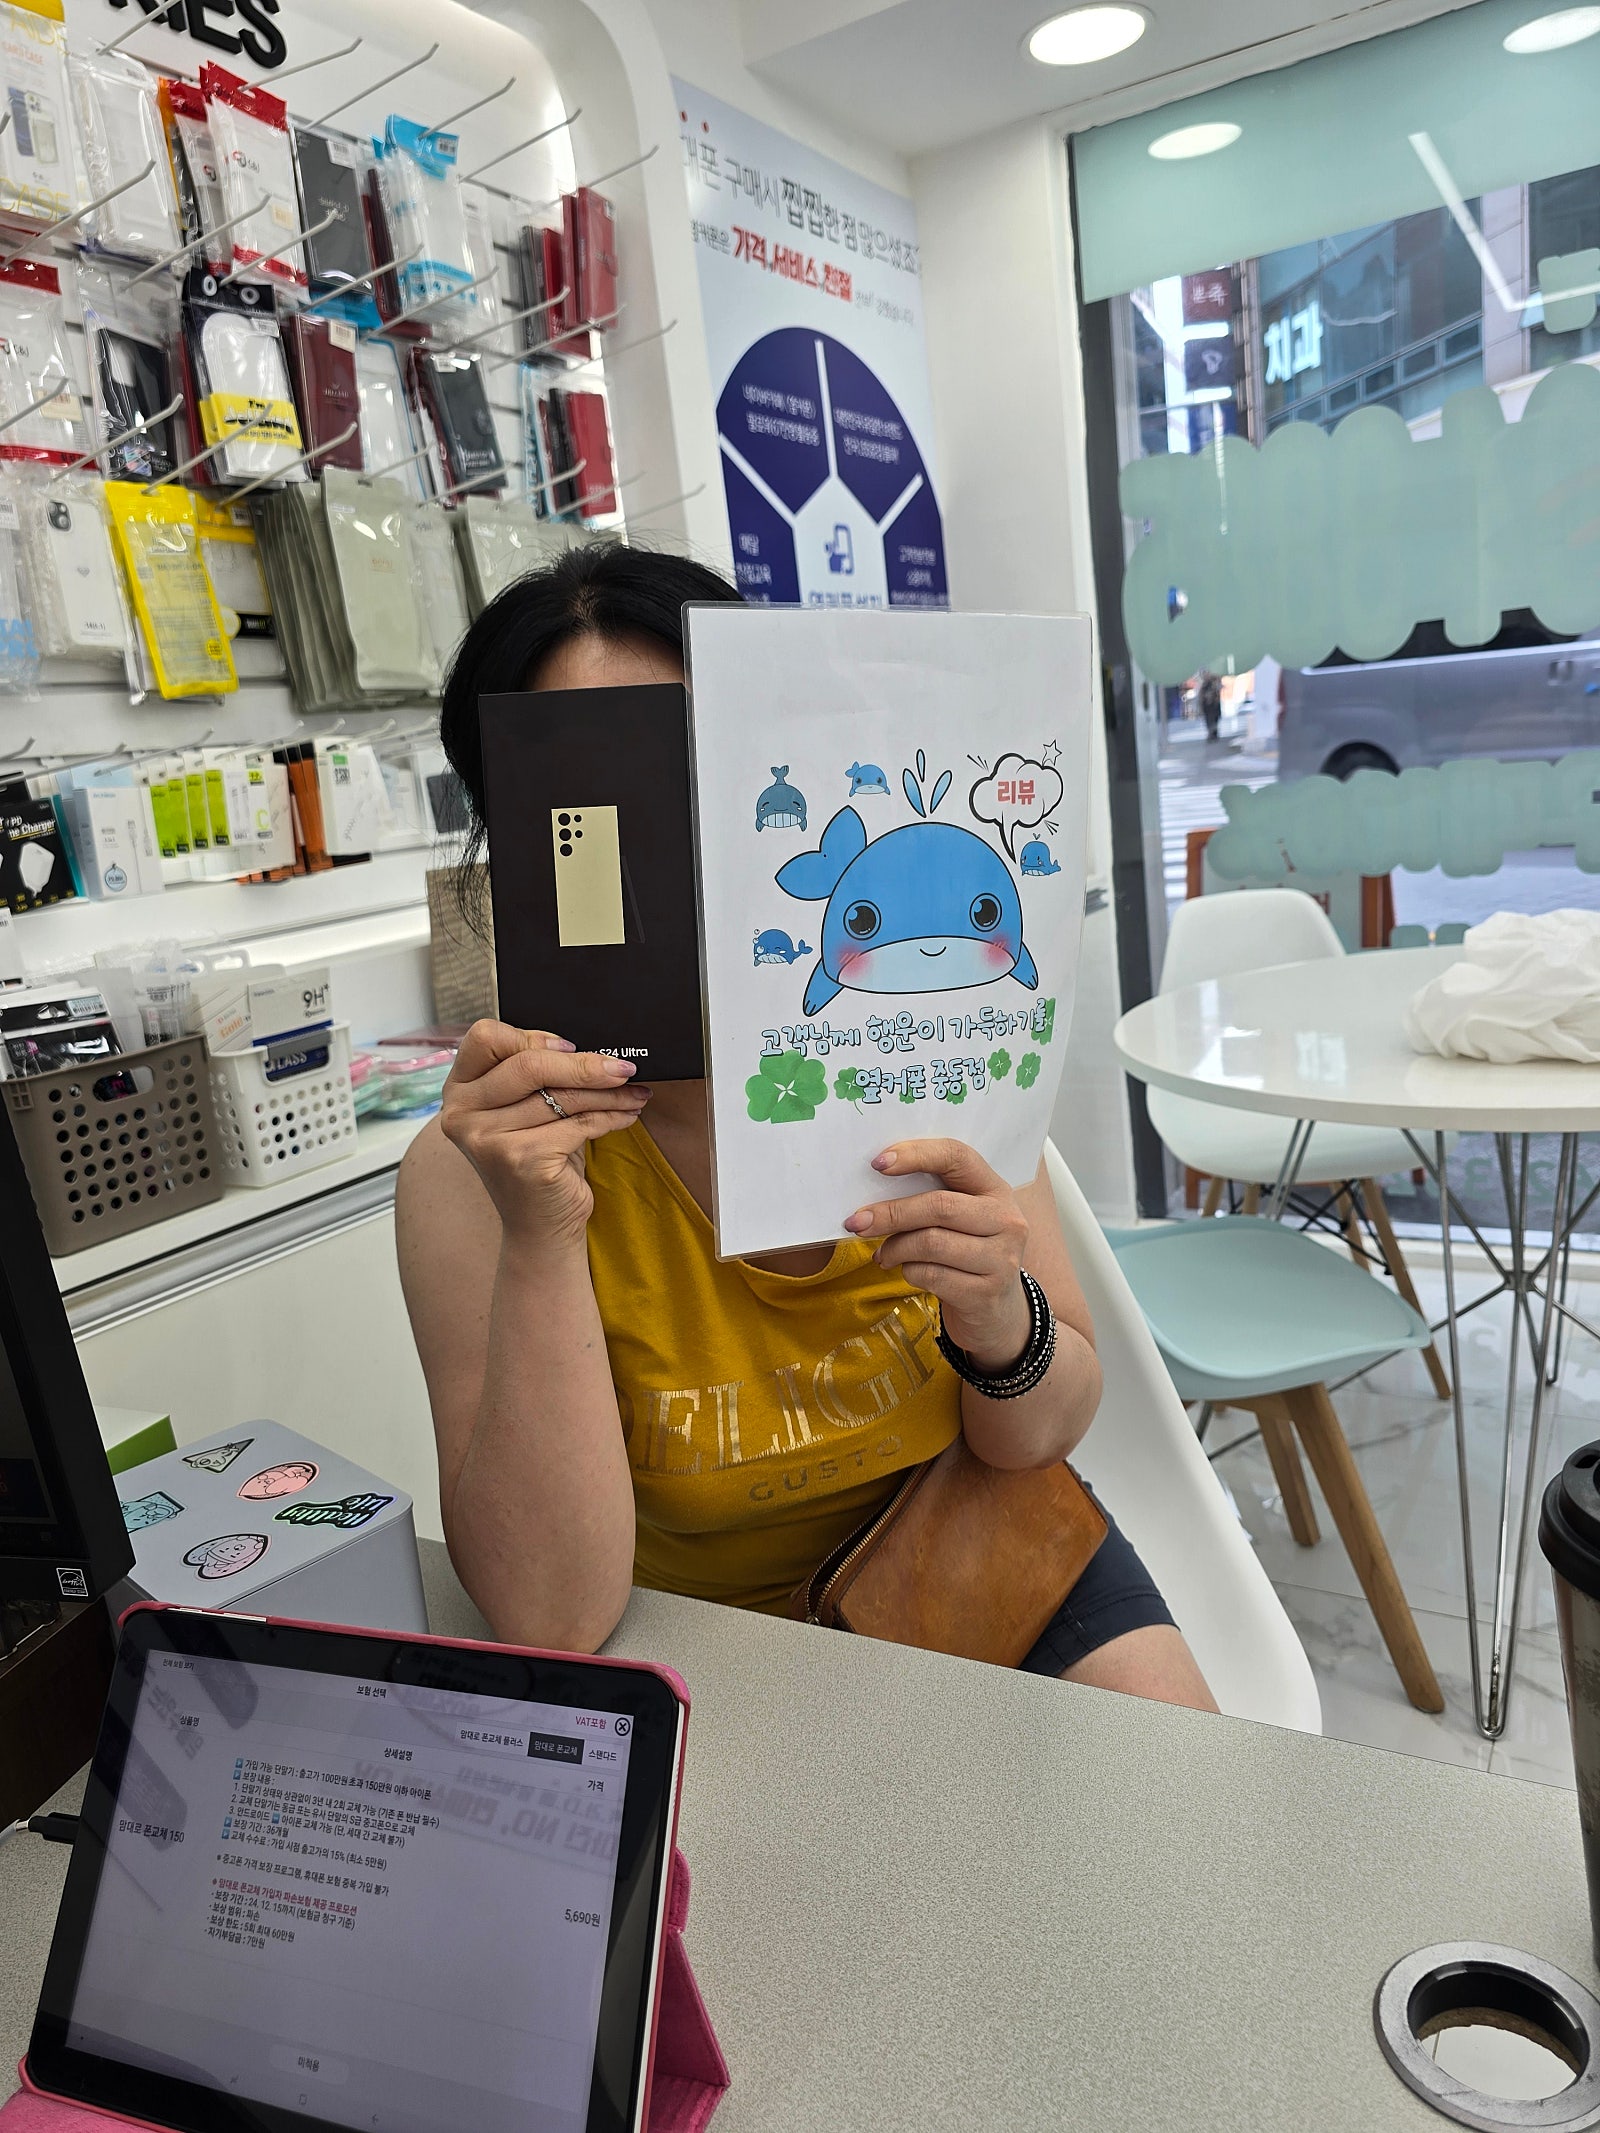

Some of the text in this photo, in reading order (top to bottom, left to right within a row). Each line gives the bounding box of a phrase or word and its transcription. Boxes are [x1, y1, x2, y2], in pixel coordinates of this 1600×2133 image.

[724, 158, 780, 218] 구매시
[781, 178, 840, 244] 찝찝한
[1264, 299, 1323, 385] 치과
[996, 779, 1036, 805] 리뷰
[760, 998, 1046, 1057] 고객님께 행운이 가득하기를
[620, 1047, 648, 1058] Ultra
[854, 1057, 987, 1104] 옆커폰 중동점
[749, 1435, 903, 1502] GUSTO
[346, 1495, 388, 1511] Life
[282, 1504, 370, 1526] Healthy
[356, 1685, 387, 1699] 보험 선택
[180, 1715, 200, 1727] 상품명
[575, 1715, 607, 1730] VAT포함
[481, 1733, 501, 1744] 폰교체
[503, 1736, 524, 1747] 플러스
[556, 1744, 578, 1757] 폰교체
[384, 1747, 413, 1762] 상세설명
[588, 1749, 617, 1762] 스탠다드
[242, 1772, 257, 1783] 보장
[245, 1759, 432, 1801] 가입 가능 단말기 출고가 100만원 초과 150만원 이하 아이폰
[587, 1779, 605, 1793] 가격
[239, 1795, 253, 1807] 교체
[254, 1797, 281, 1812] 단말기는
[296, 1805, 311, 1817] 또는
[311, 1808, 326, 1820] 유사
[327, 1810, 349, 1824] 단말의
[349, 1815, 362, 1827] S급
[363, 1817, 399, 1833] 중고폰으로
[400, 1824, 416, 1837] 교체
[242, 1783, 261, 1796] 단말기
[262, 1787, 283, 1800] 상태와
[284, 1791, 312, 1805] 상관없이
[312, 1796, 324, 1807] 3년
[346, 1801, 361, 1814] 교체
[362, 1804, 377, 1817] 가능
[377, 1807, 396, 1820] (기존
[396, 1810, 405, 1821] 폰
[406, 1812, 421, 1824] 반납
[422, 1815, 440, 1829] 필수)
[143, 1824, 169, 1841] 폰교체
[169, 1830, 185, 1843] 150
[233, 1819, 289, 1838] 보장 기간 36개월
[237, 1807, 271, 1821] 안드로이드
[281, 1815, 302, 1828] 아이폰
[303, 1819, 318, 1831] 교체
[318, 1822, 333, 1834] 가능
[347, 1827, 361, 1840] 세대
[362, 1830, 370, 1841] 간
[371, 1832, 387, 1844] 교체
[387, 1835, 405, 1848] 불가)
[230, 1830, 388, 1872] 교체 수수료 가입 시점 출고가의 15% (최소 5만원)
[222, 1853, 390, 1896] 중고폰 가격 보장 프로그램, 휴대폰 보험 중복 가입 불가
[212, 1902, 260, 1922] 보상 범위 파손
[214, 1890, 356, 1931] 보장 기간 24. 12. 15까지 (보험금 청구 기준)
[261, 1887, 283, 1900] 가입자
[283, 1892, 312, 1908] 파손보험
[312, 1898, 328, 1910] 제공
[328, 1901, 358, 1917] 프로모션
[210, 1915, 296, 1943] 보상 한도 5회 최대 60만원
[565, 1908, 601, 1928] 5,690원
[208, 1926, 266, 1950] 자기부담금 7만원
